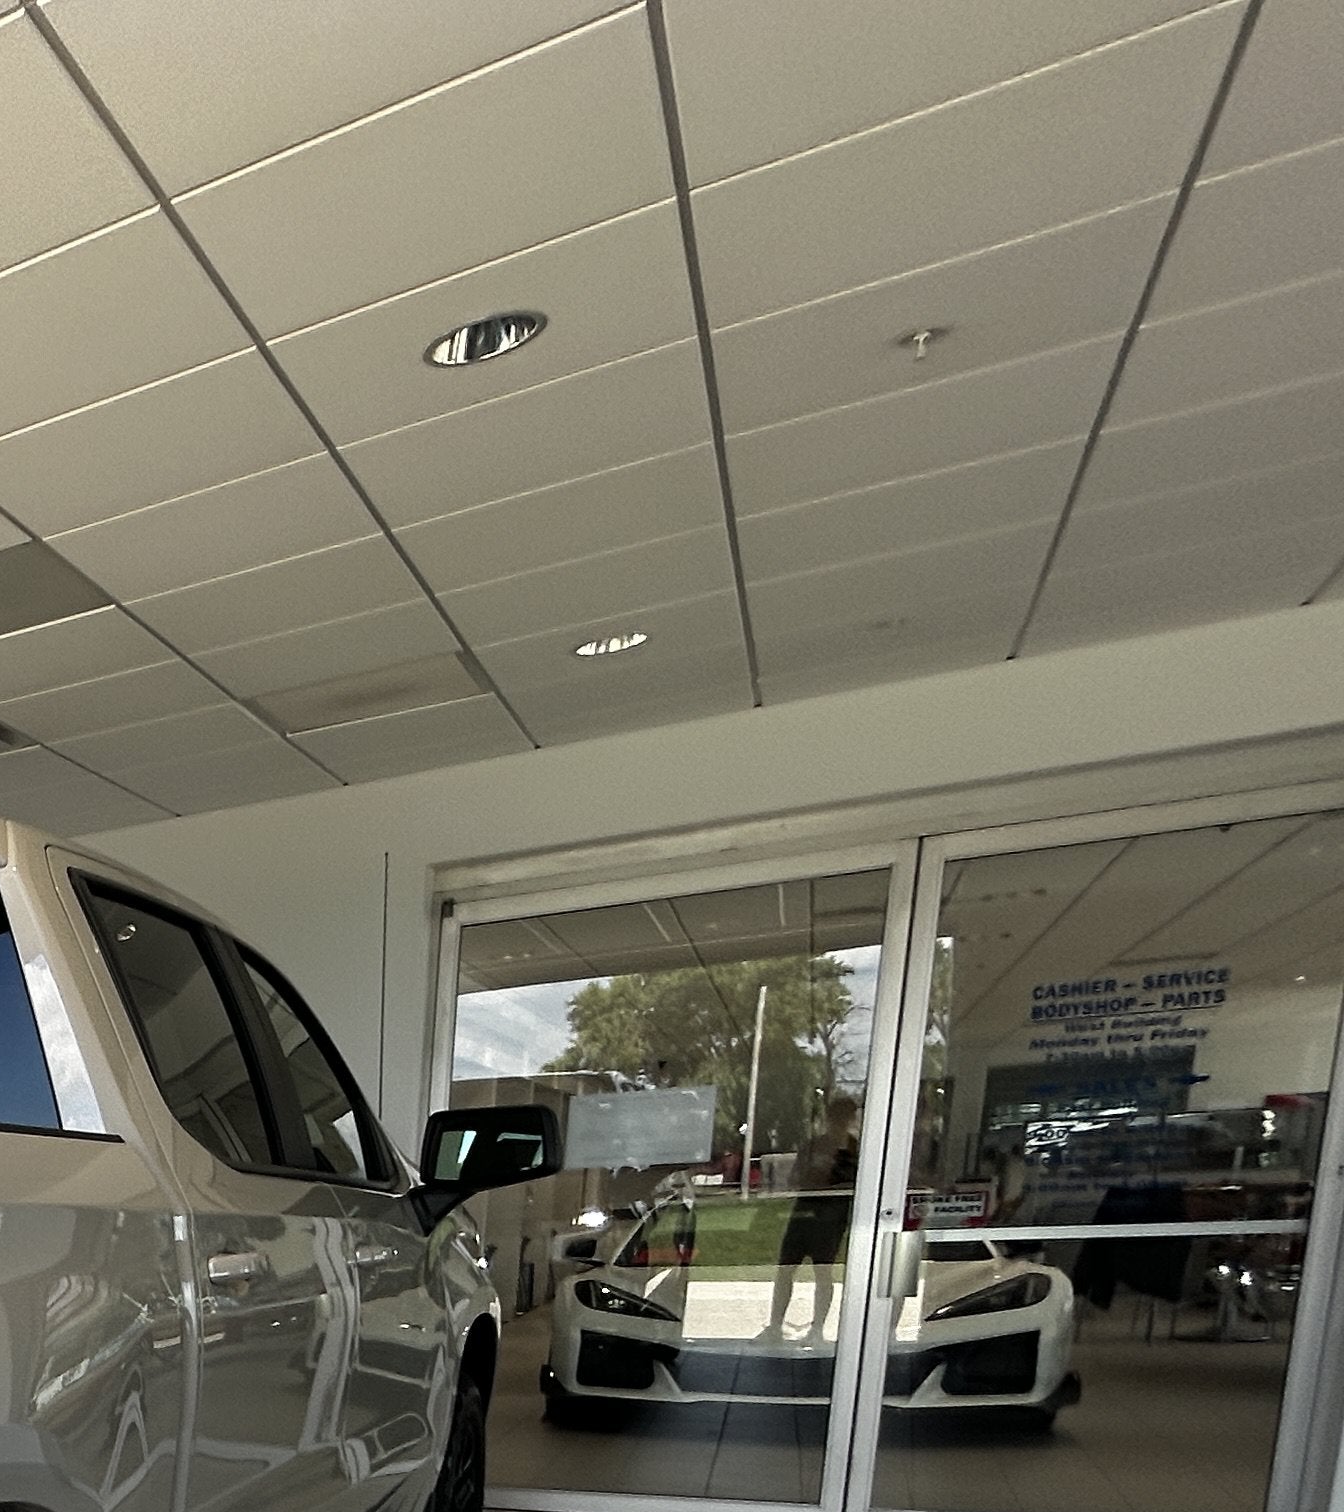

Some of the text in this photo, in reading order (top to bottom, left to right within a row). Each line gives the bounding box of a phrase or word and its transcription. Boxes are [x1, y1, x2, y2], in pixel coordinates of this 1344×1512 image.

[1032, 978, 1118, 1001] CASHIER
[1142, 967, 1231, 991] SERVICE
[1030, 996, 1137, 1020] BODYSHOP
[1161, 988, 1227, 1008] PARTS
[1150, 1026, 1210, 1041] Friday
[934, 1205, 982, 1213] FACILITY
